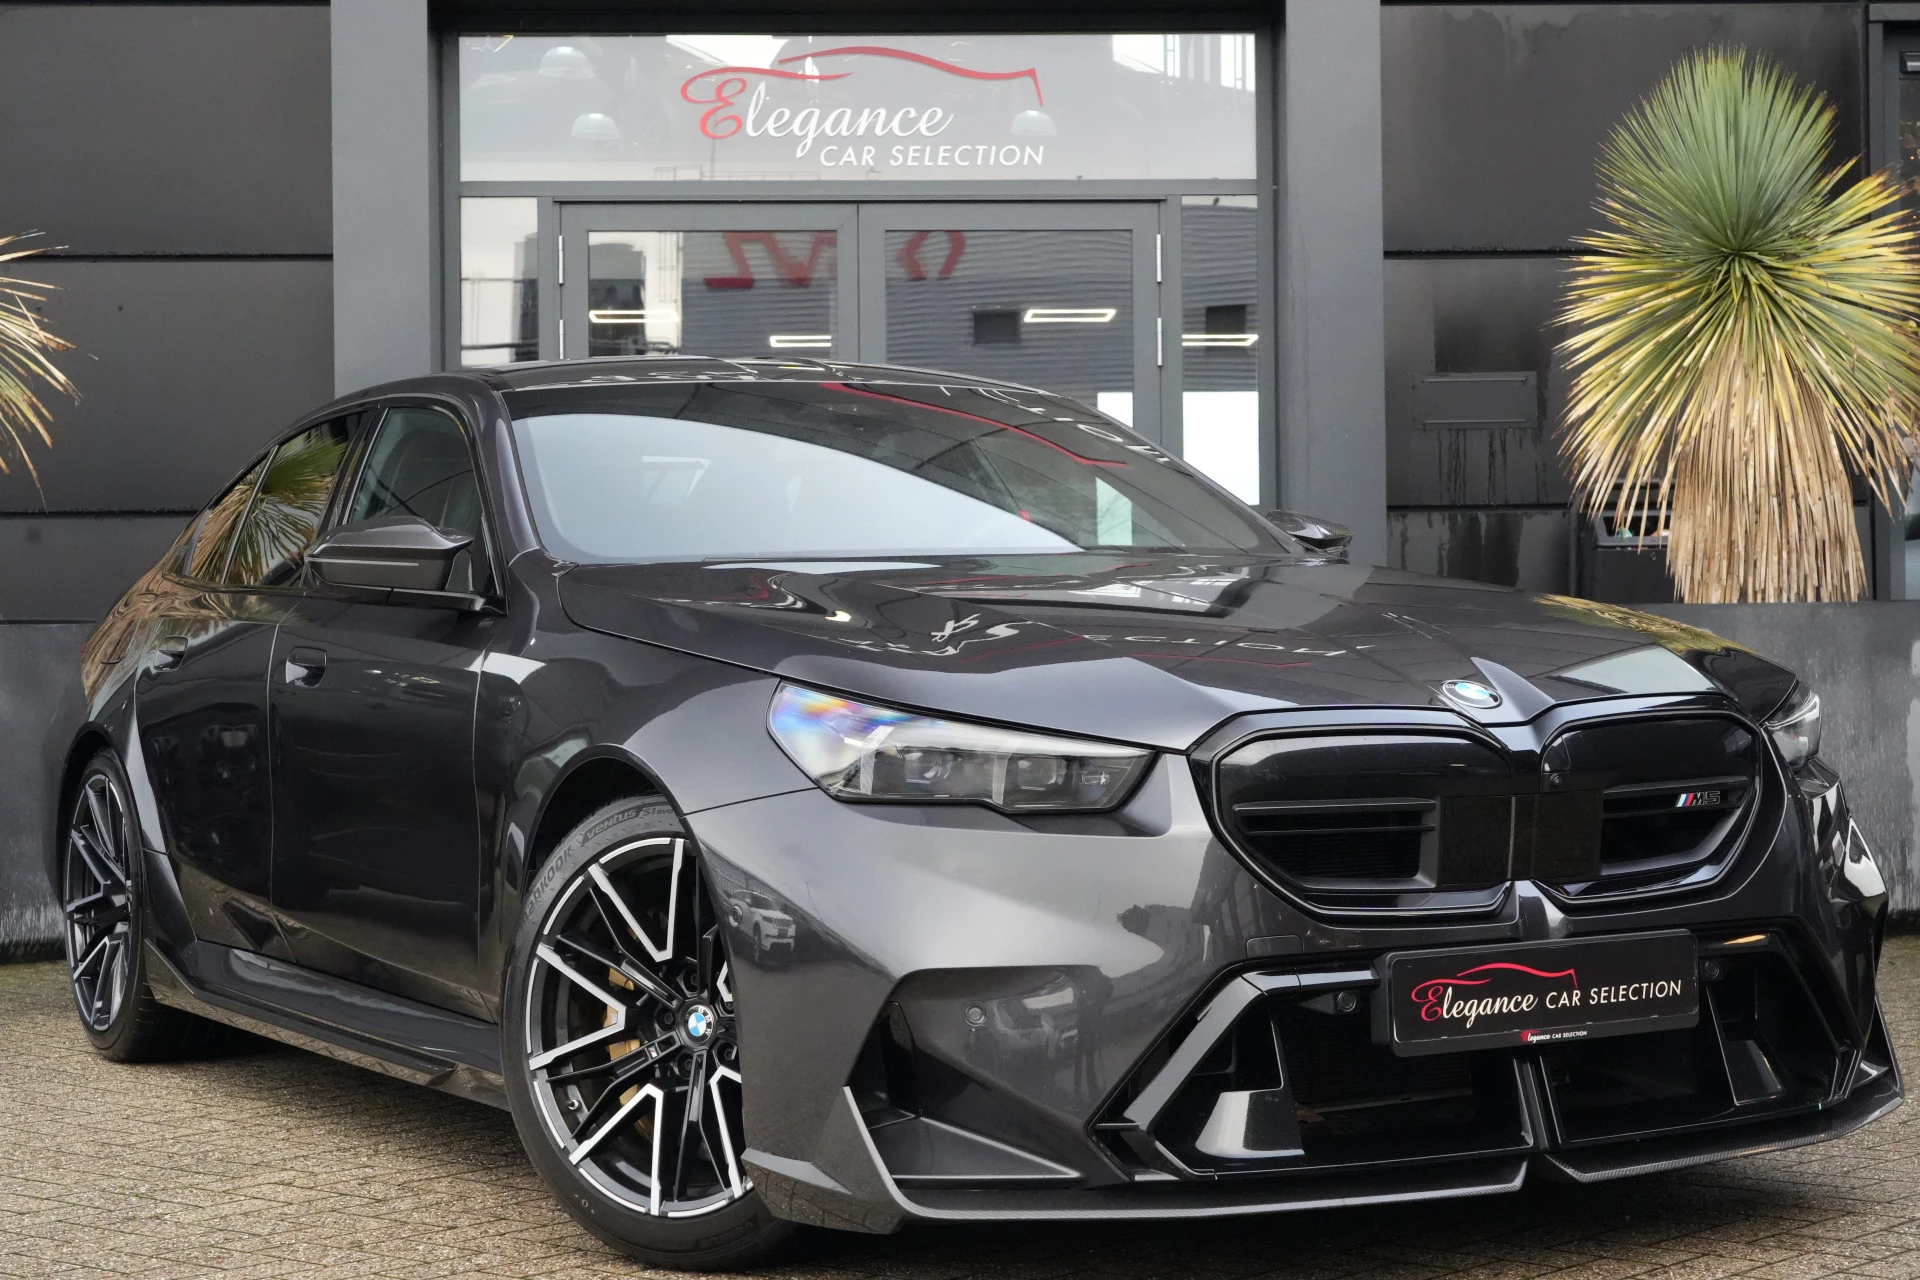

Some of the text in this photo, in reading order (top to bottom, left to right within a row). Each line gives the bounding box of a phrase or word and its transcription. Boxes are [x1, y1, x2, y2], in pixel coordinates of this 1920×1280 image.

[682, 68, 953, 158] Elegance
[819, 144, 1044, 166] CAR SELECTION
[1691, 791, 1720, 806] M5
[1411, 979, 1681, 1028] Elegance CAR SELECTION
[1562, 1030, 1588, 1038] SELECTION
